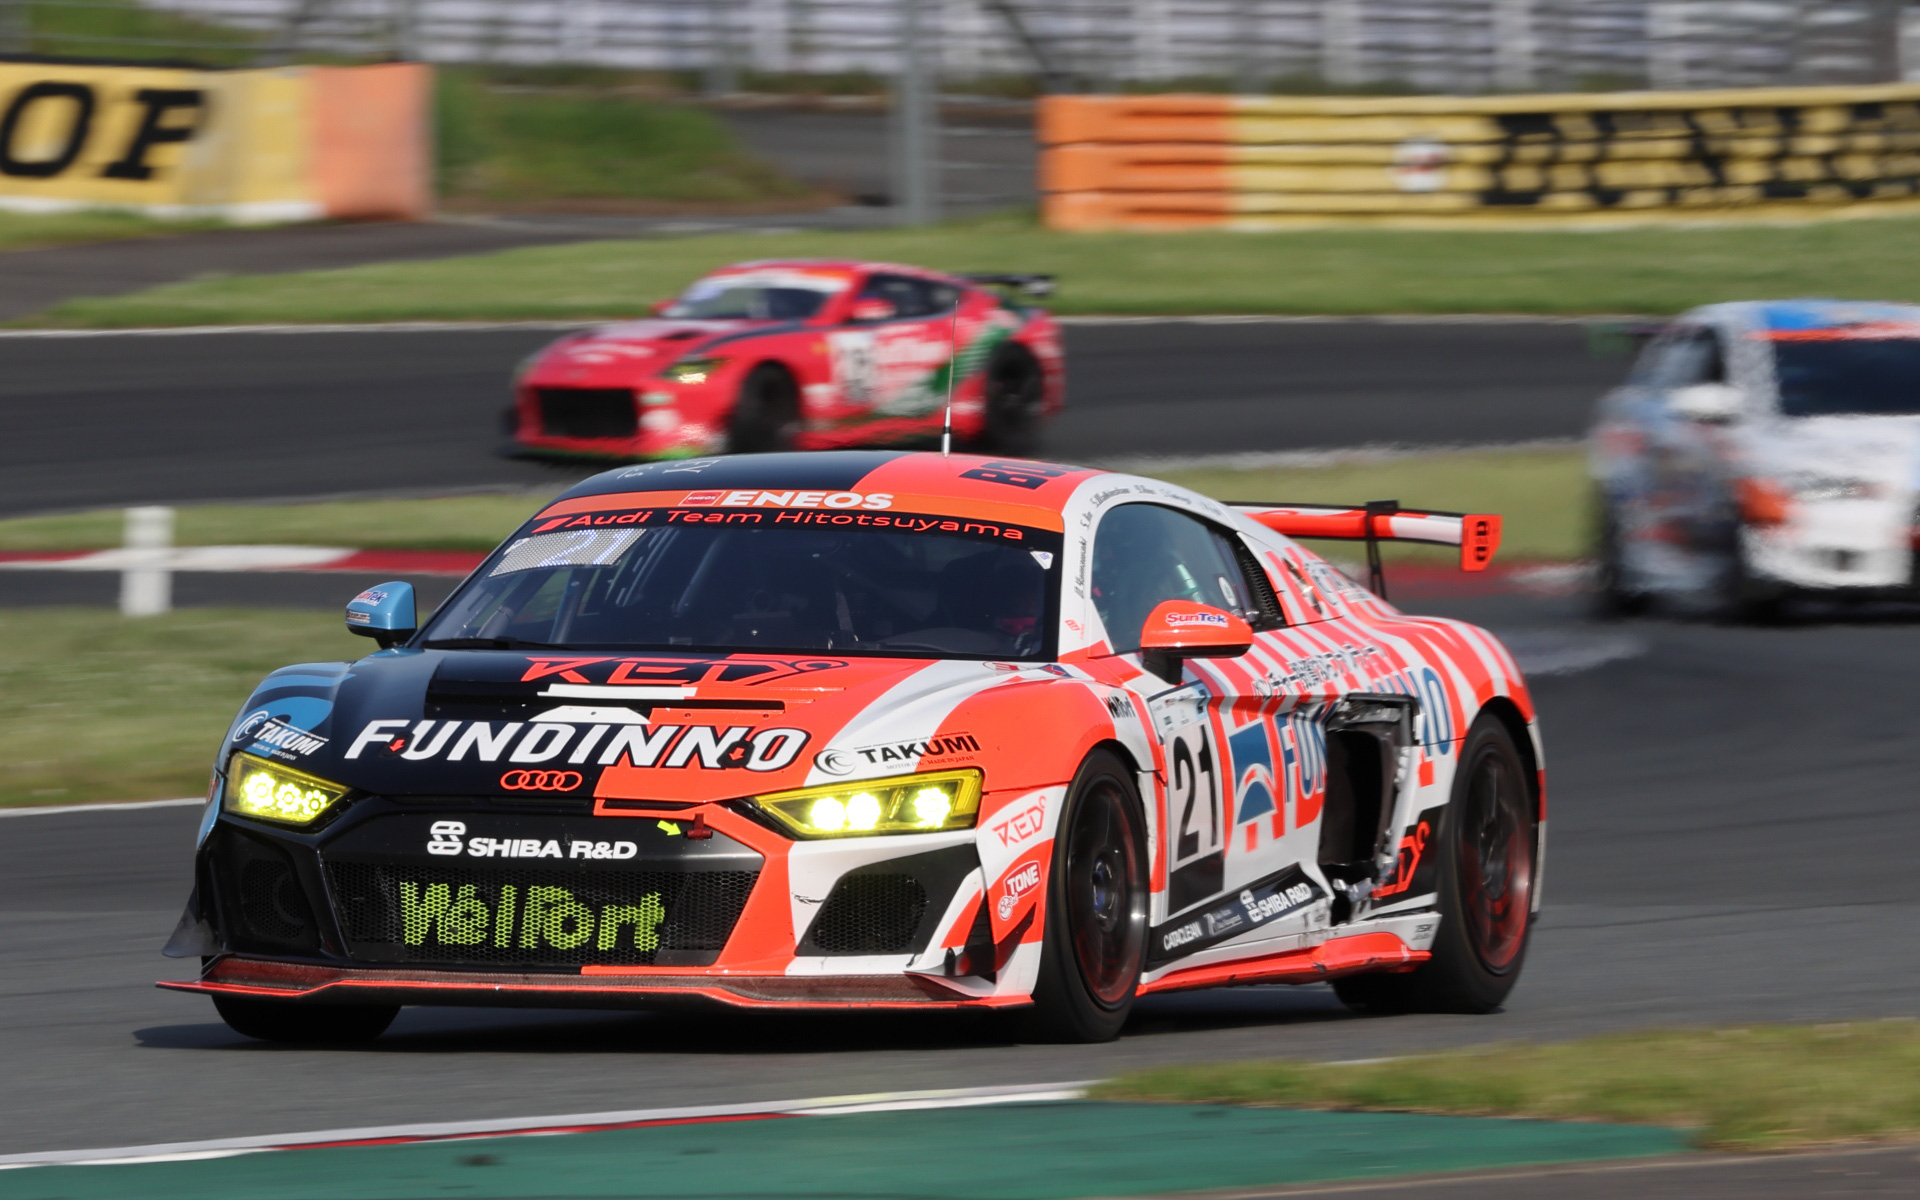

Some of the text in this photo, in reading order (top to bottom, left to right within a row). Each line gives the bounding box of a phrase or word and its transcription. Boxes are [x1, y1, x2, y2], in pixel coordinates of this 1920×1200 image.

[720, 490, 894, 510] ENEOS
[565, 510, 1023, 540] Audi Team Hitotsuyama
[537, 528, 635, 567] 21
[1166, 612, 1227, 624] SunTek
[254, 721, 326, 756] TAKUMI
[344, 718, 809, 771] FUNDINNO
[857, 735, 982, 764] TAKUMI
[955, 755, 975, 763] JAPAN
[1173, 724, 1217, 861] 21
[468, 838, 638, 859] SHIBA R&D
[1007, 864, 1039, 895] TONE
[1259, 882, 1312, 917] SHIBA R&D
[1164, 921, 1203, 951] CATACLEAN
